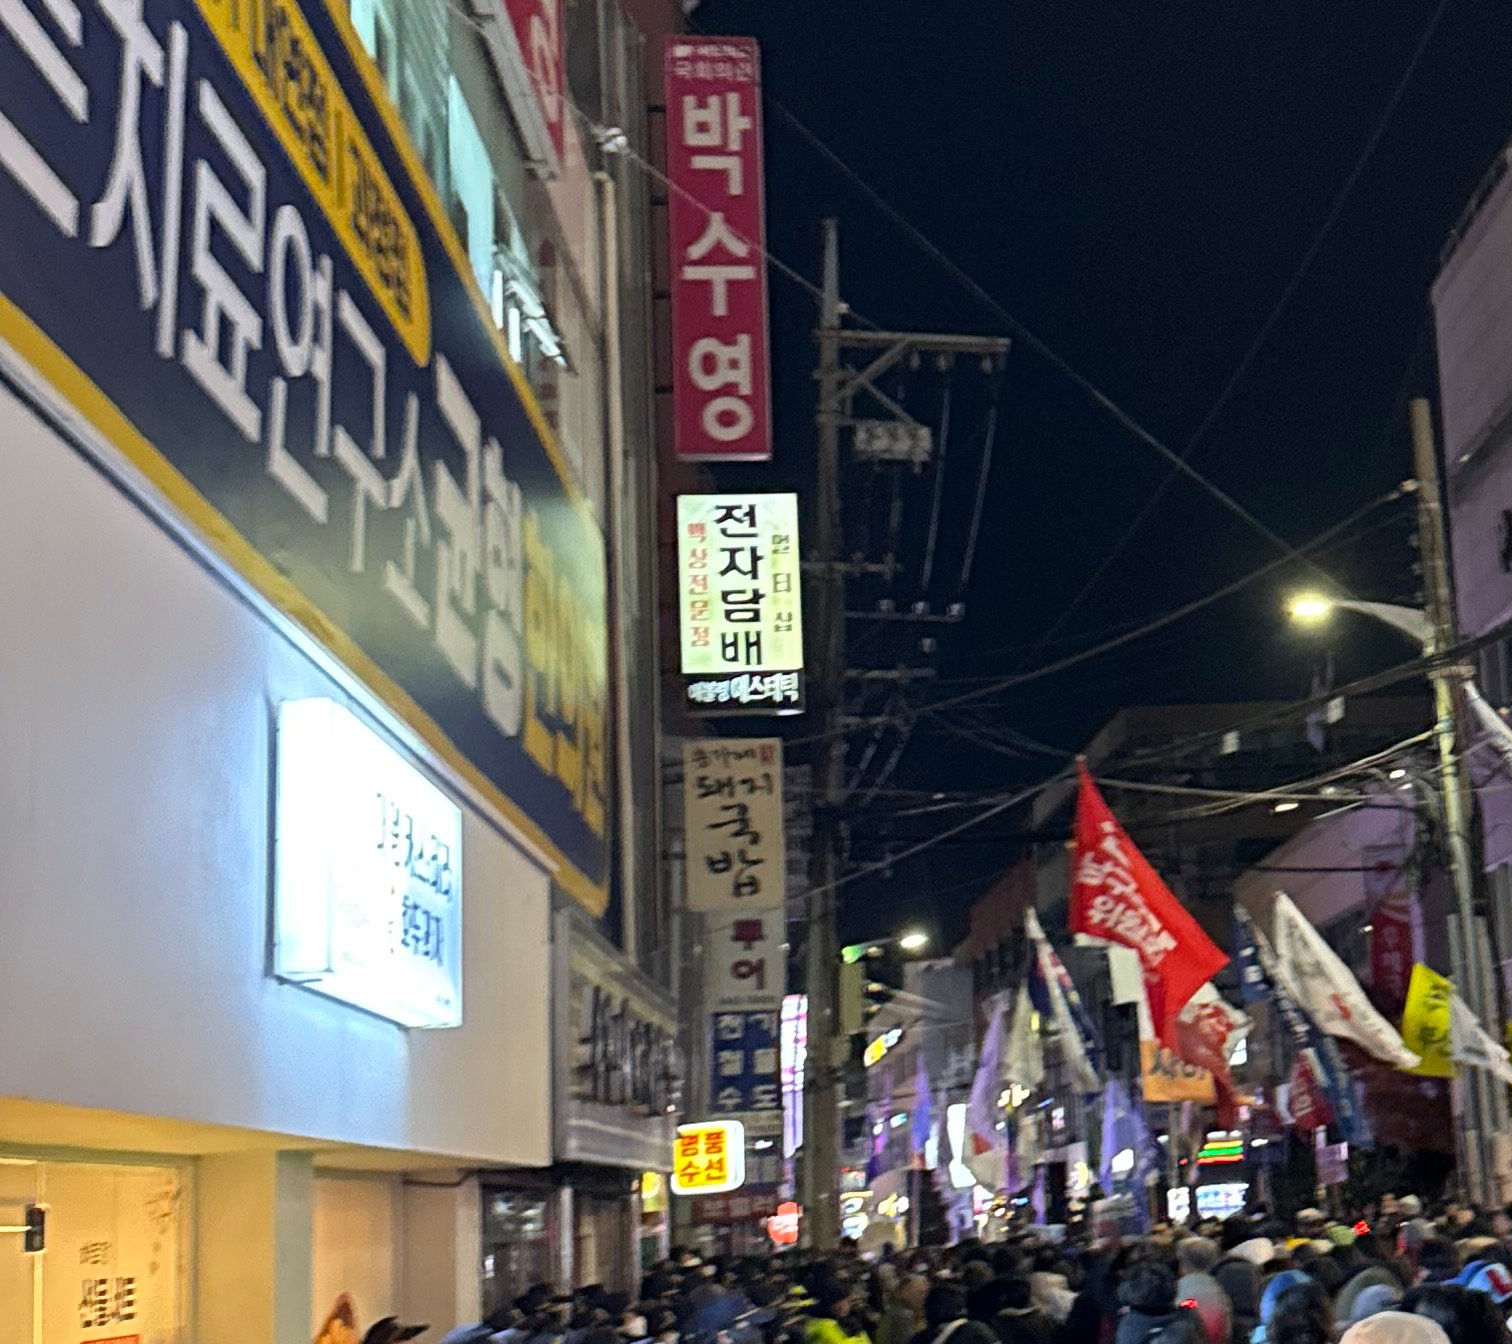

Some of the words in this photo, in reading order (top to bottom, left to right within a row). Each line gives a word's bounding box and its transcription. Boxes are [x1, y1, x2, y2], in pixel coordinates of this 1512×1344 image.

[681, 92, 757, 442] 박수영
[714, 504, 766, 666] 전자담배
[680, 1158, 725, 1184] 수선
[681, 1132, 725, 1157] 명품
